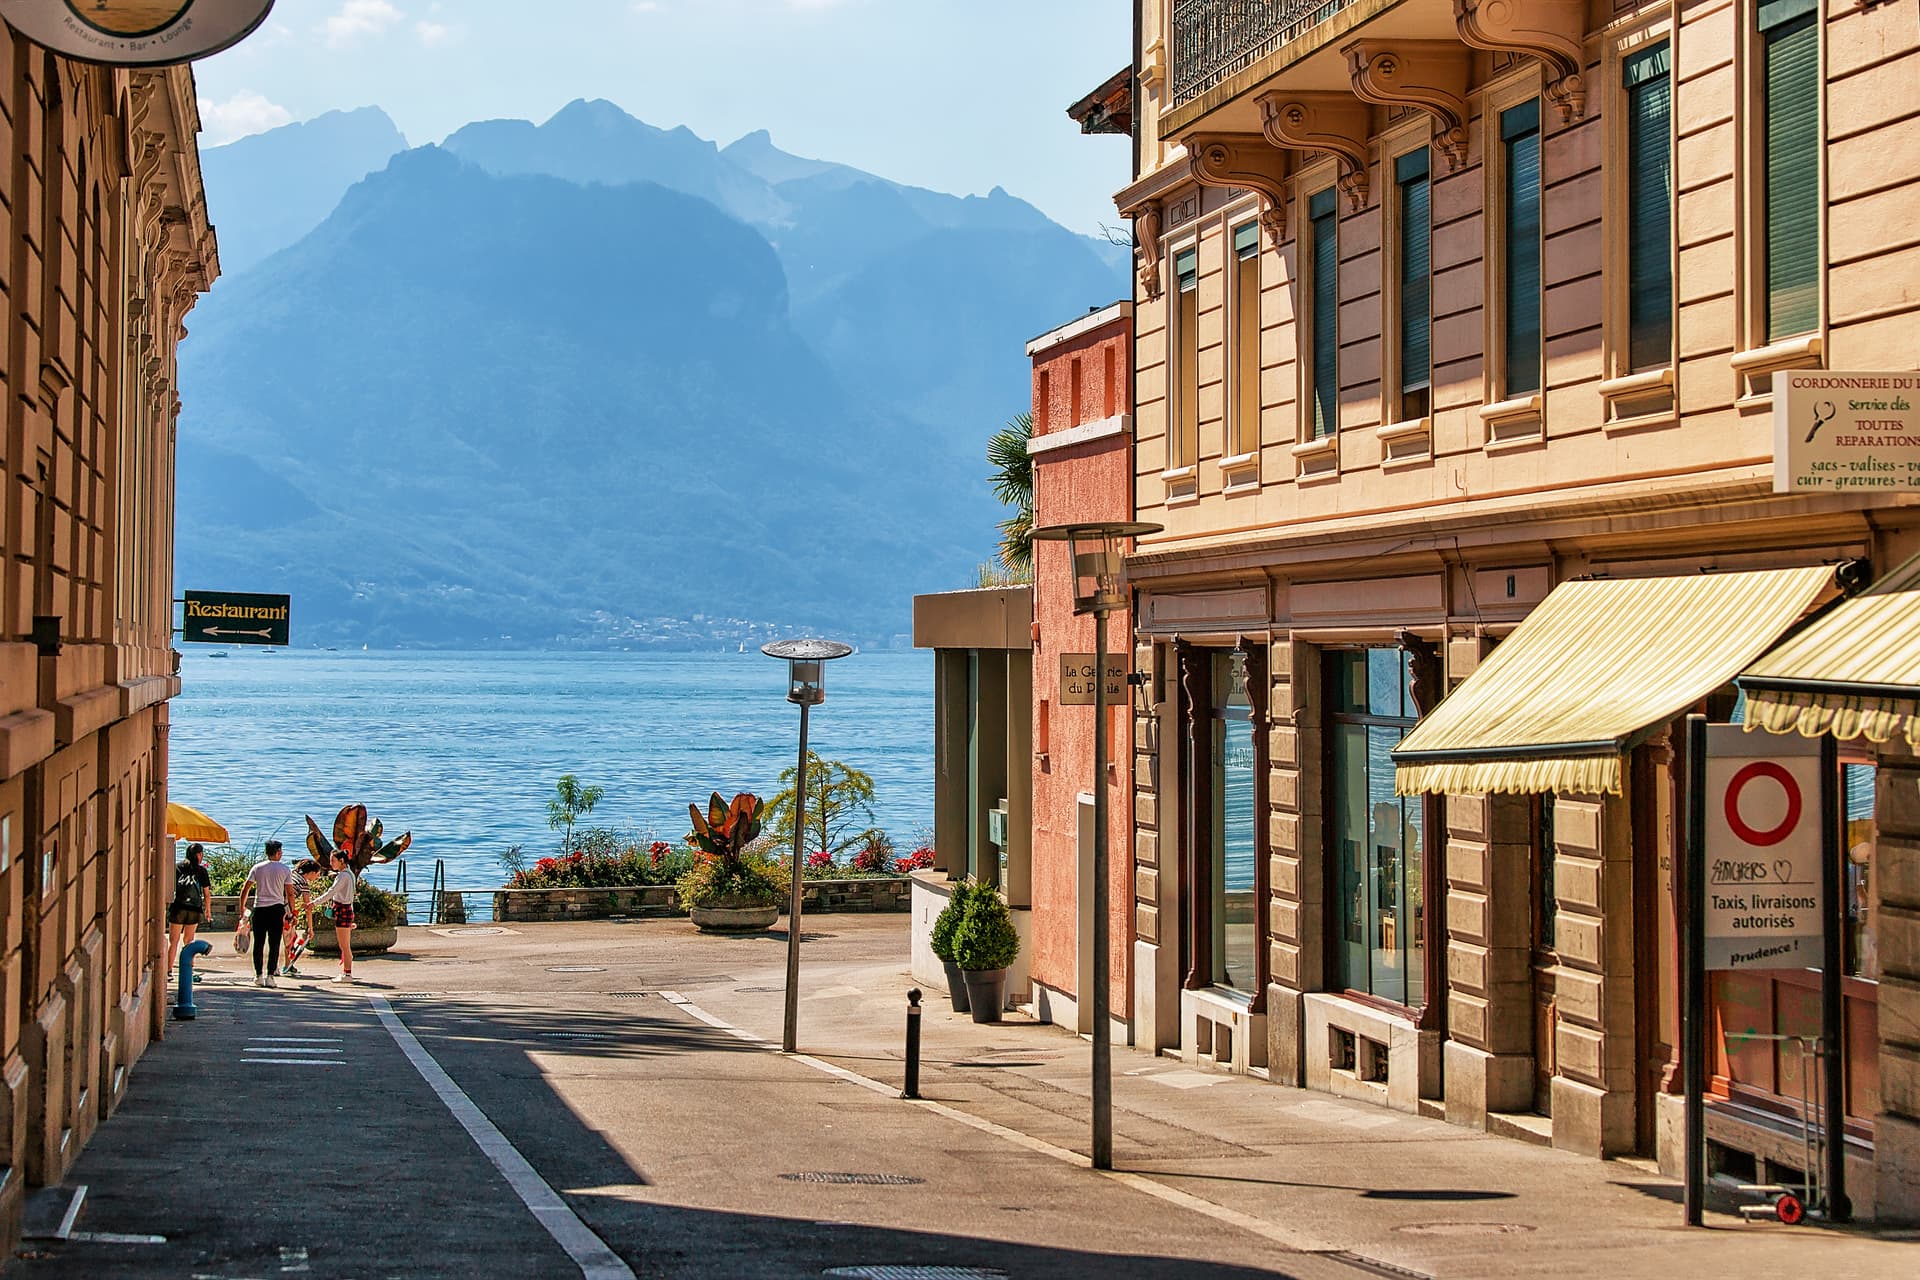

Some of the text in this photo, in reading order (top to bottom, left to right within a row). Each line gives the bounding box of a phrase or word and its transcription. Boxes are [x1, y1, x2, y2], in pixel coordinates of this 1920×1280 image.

[63, 16, 193, 51] Restaurant Bar Lounge
[1792, 377, 1890, 389] CORDONNERIE
[1893, 378, 1913, 389] DU
[1848, 398, 1888, 411] Service
[1855, 420, 1904, 431] TOUTES
[1835, 436, 1920, 447] REPARATIONS
[1811, 461, 1838, 472] sacs
[1849, 455, 1896, 472] valises
[1797, 472, 1824, 486] cuir
[1835, 475, 1896, 490] gravures
[187, 600, 288, 620] Restaurant
[1065, 665, 1123, 678] La Garie
[1068, 682, 1083, 694] du
[1711, 894, 1817, 911] Taxis, livraisons
[1732, 913, 1796, 929] autorisés
